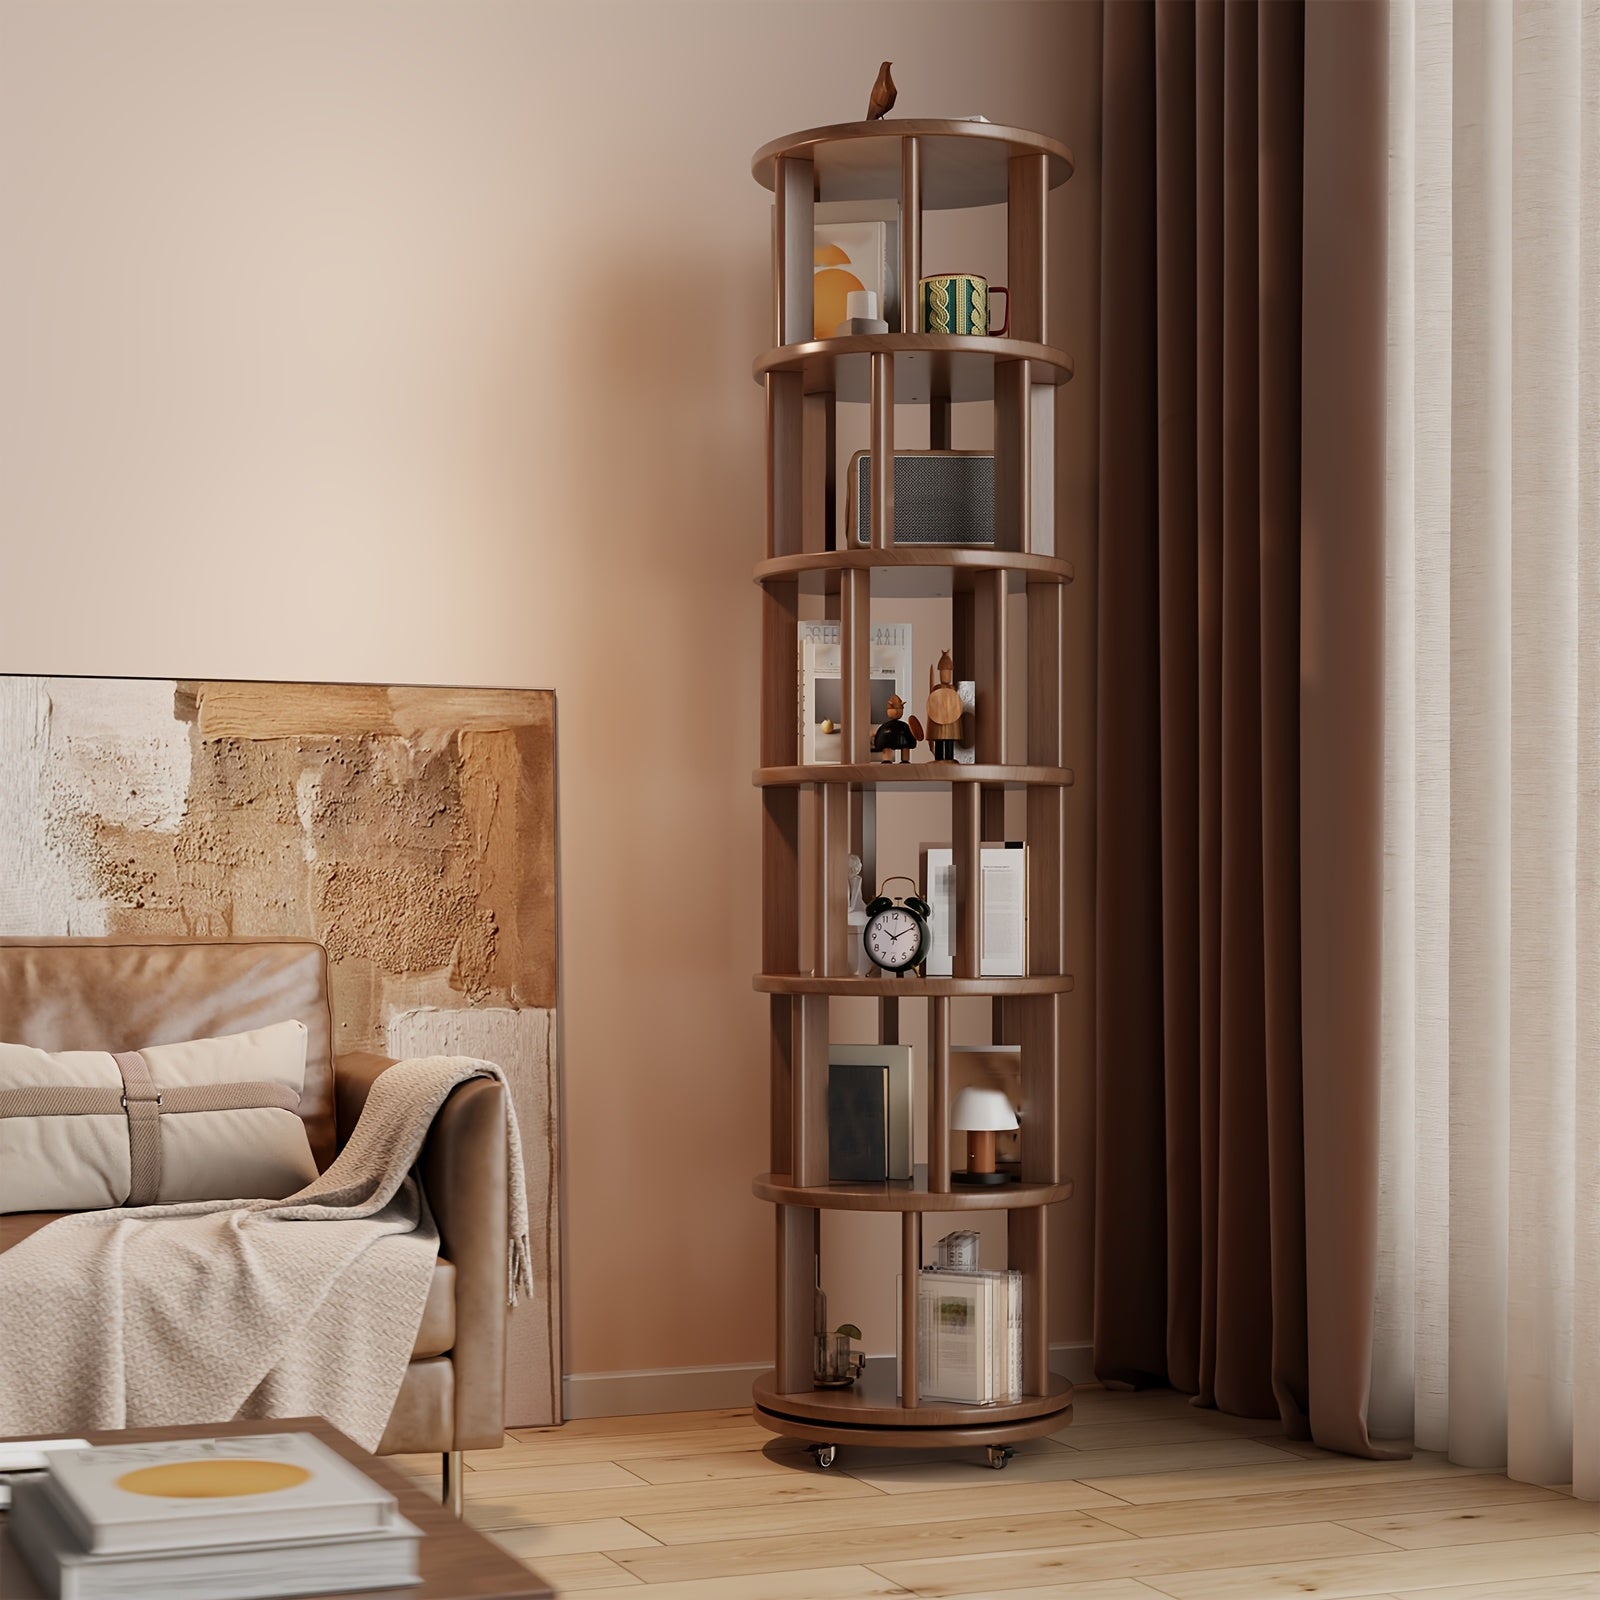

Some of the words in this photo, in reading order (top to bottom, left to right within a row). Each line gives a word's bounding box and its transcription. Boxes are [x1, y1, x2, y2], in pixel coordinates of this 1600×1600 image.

[882, 915, 889, 923] 11
[891, 912, 899, 920] 12
[874, 922, 882, 931] 10
[910, 922, 916, 930] 2
[913, 933, 919, 942] 3
[873, 943, 880, 952] 8
[881, 951, 887, 959] 7
[890, 954, 896, 963] 6
[901, 951, 907, 960] 5
